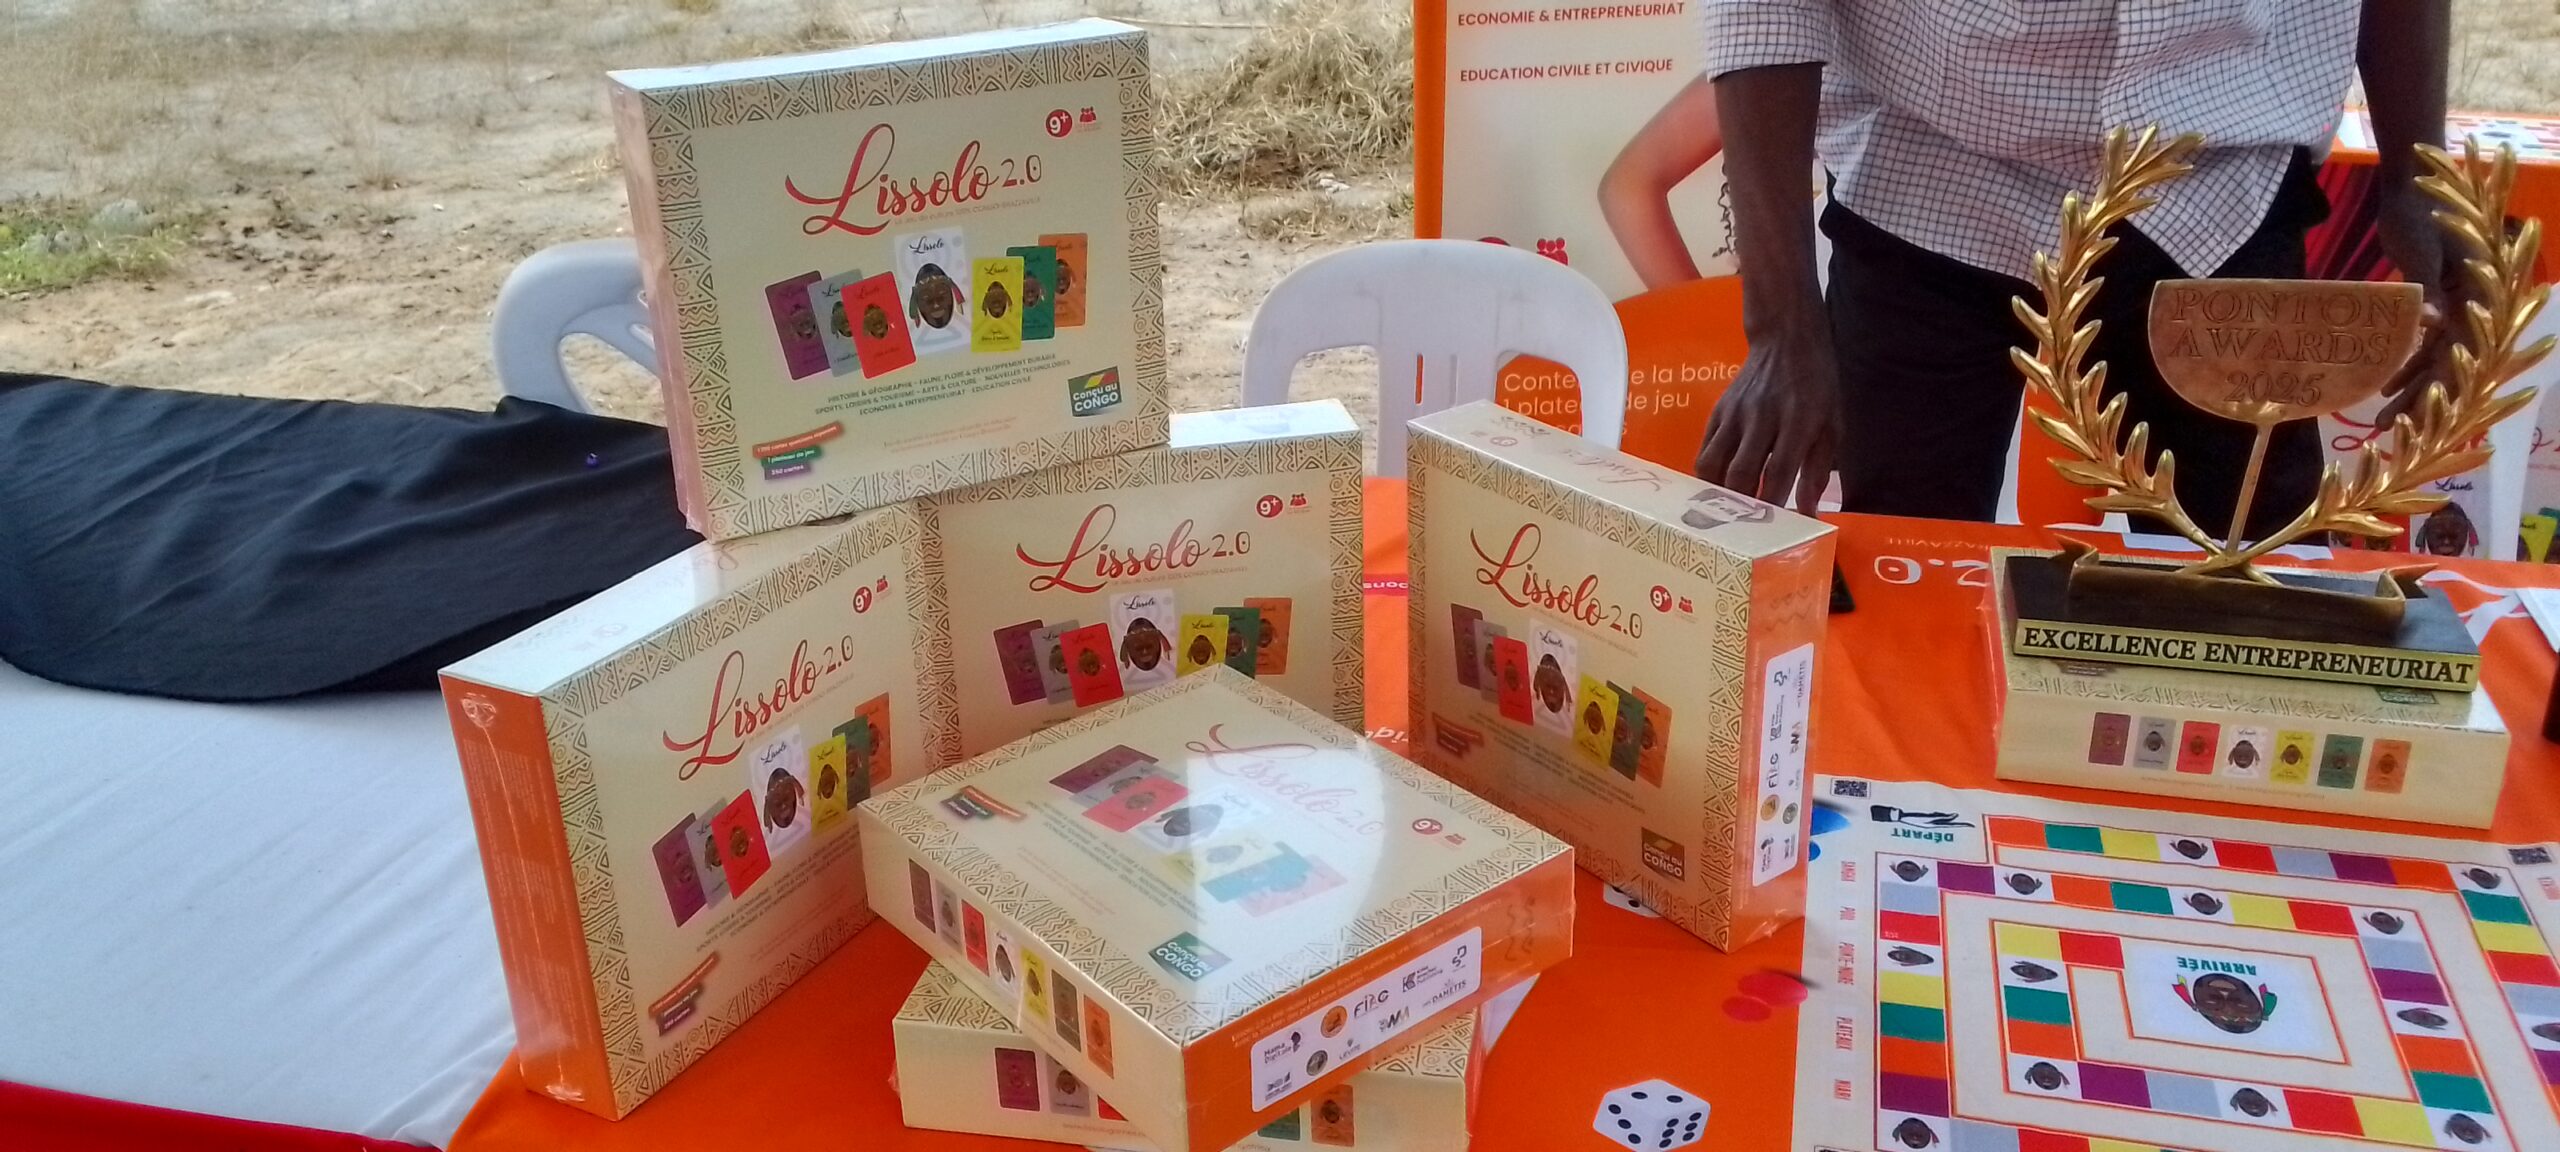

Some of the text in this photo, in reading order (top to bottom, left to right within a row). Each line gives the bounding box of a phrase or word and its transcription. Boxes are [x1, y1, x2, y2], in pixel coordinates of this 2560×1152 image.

[1458, 2, 1685, 26] ECONOMIE & ENTREPRENEURIAT
[1460, 58, 1673, 82] EDUCATION CIVILE ET CIVIQUE
[785, 123, 1042, 236] Lissolo 2.0
[2172, 288, 2404, 328] PONTON
[2169, 328, 2391, 365] AWARDS
[1504, 372, 1578, 392] Conte
[1652, 365, 1672, 384] la
[1681, 361, 1742, 383] boîte
[2223, 371, 2325, 406] 2025
[1074, 391, 1119, 411] CONGO
[1518, 396, 1578, 417] plate
[1653, 389, 1690, 415] jeu
[1015, 503, 1251, 593] Lissolo 2.0
[1470, 522, 1643, 639] Lissolo 2.0
[1873, 556, 1988, 587] 2.0
[2023, 627, 2472, 685] EXCELLENCE ENTREPRENEURIAT
[662, 635, 854, 782] Lissolo 2.0
[1185, 723, 1340, 814] Lissolo
[1891, 828, 1954, 843] DÉPART
[1644, 853, 1682, 877] CONGO
[1156, 947, 1202, 977] CONGO
[2176, 956, 2258, 977] ARRIVÉE
